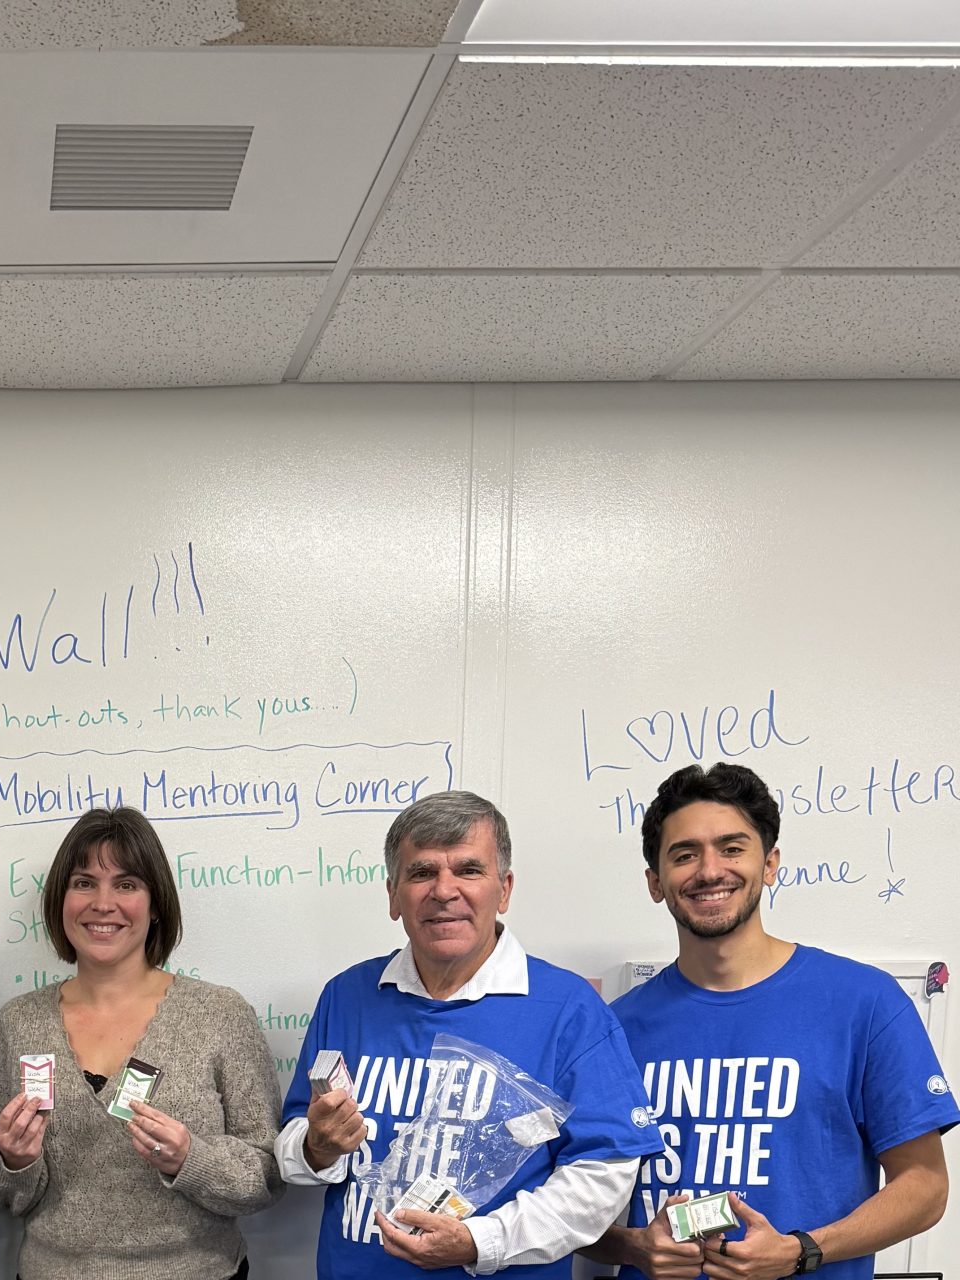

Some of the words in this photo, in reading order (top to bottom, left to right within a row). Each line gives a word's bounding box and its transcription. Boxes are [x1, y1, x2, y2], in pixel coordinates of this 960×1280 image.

[153, 693, 242, 721] thank
[142, 769, 301, 830] Mentoring
[314, 761, 431, 810] Corner
[599, 788, 645, 834] Th
[352, 1054, 497, 1122] UNITED
[642, 1056, 801, 1119] UNITED
[693, 1122, 773, 1186] THE
